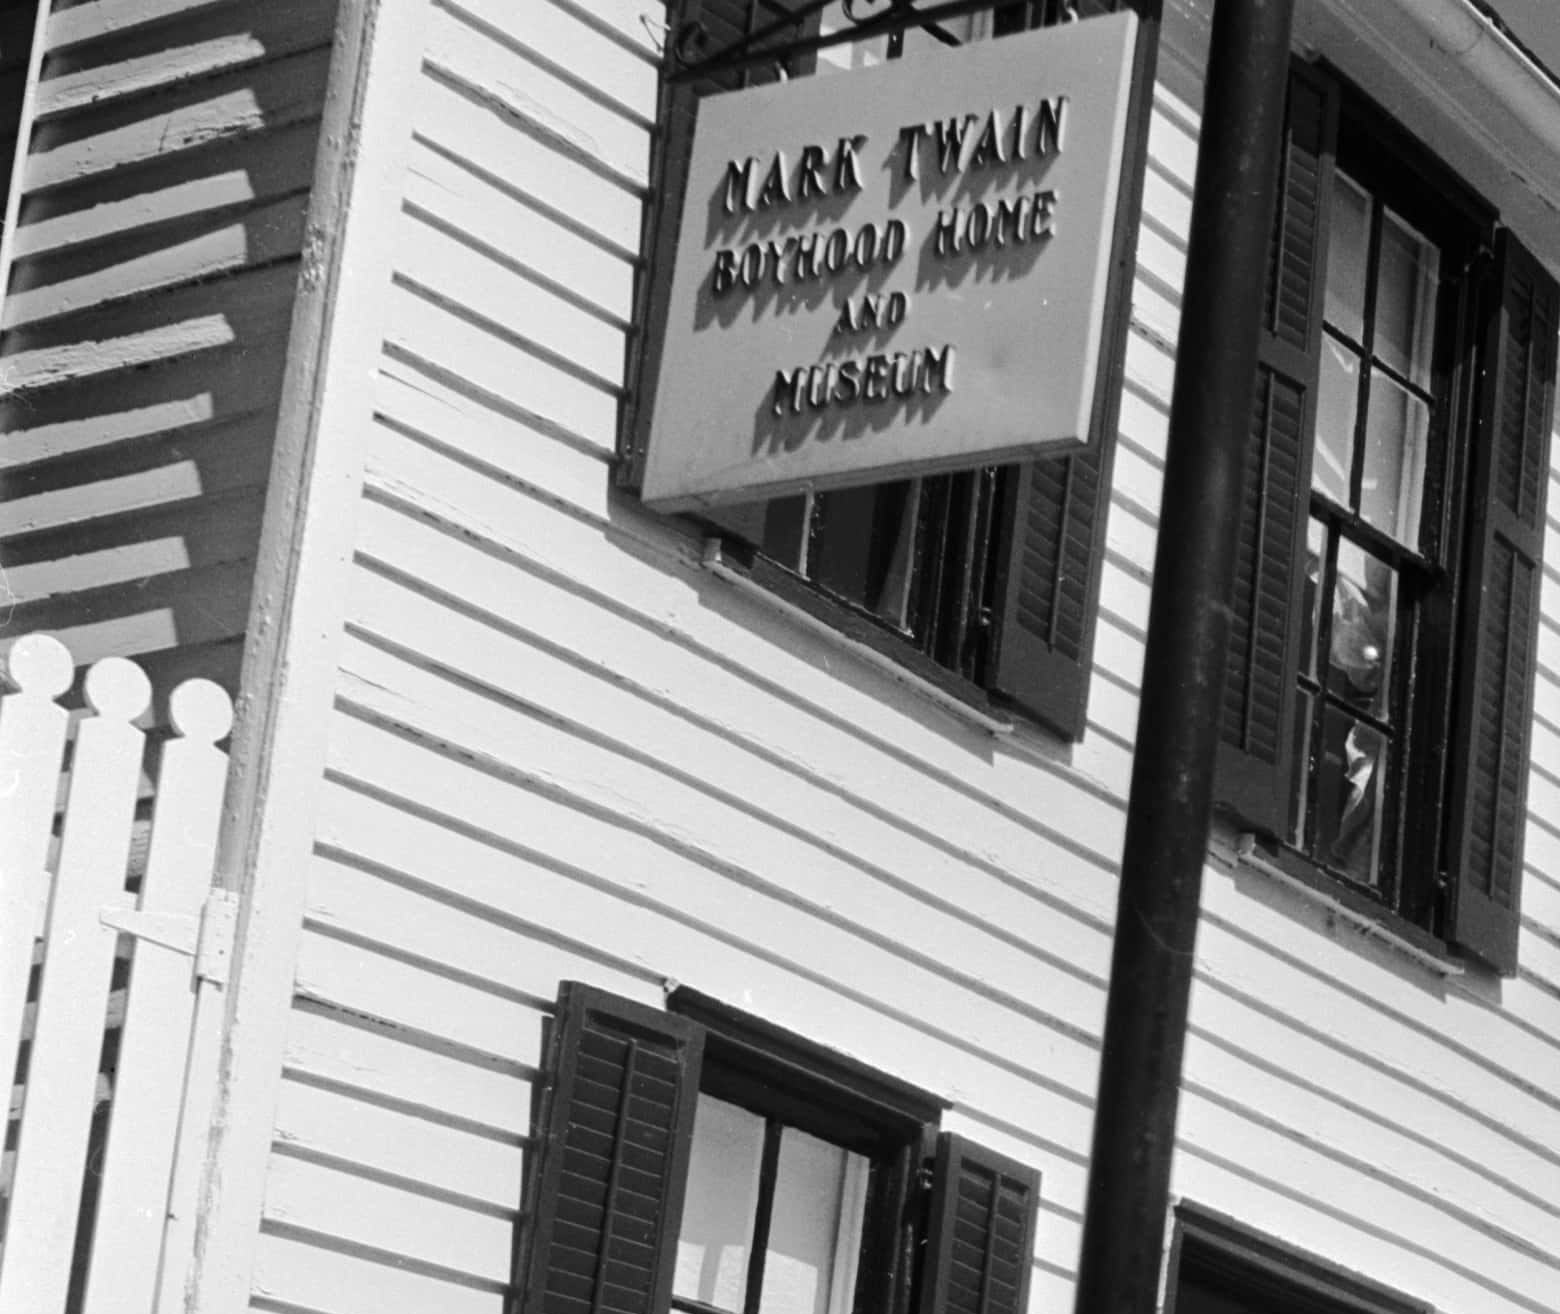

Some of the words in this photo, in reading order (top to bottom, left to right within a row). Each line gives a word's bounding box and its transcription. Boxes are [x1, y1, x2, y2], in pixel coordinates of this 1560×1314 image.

[725, 134, 868, 213] MARK
[899, 96, 1069, 182] TWAIN
[713, 218, 911, 292] BOYHOOD
[934, 190, 1056, 257] HOME
[836, 291, 911, 333] AND
[773, 344, 957, 416] MUSEUM
